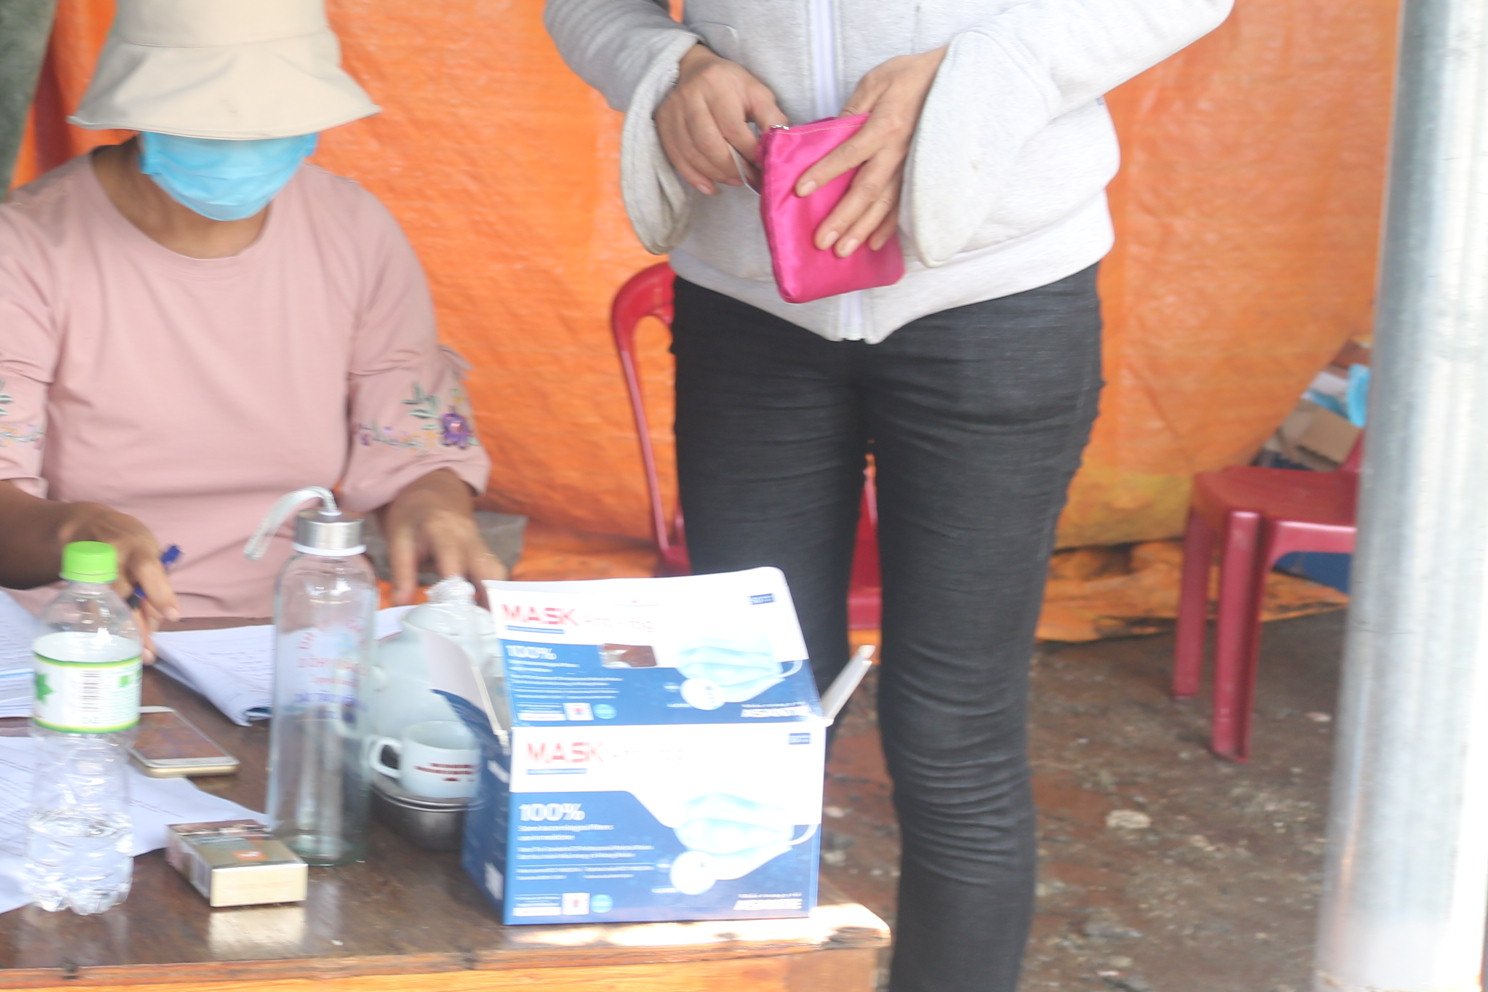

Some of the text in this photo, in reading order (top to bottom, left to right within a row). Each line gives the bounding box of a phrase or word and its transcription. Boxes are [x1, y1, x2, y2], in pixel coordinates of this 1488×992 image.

[502, 604, 578, 626] MASK
[527, 741, 605, 764] MASK
[518, 803, 586, 822] 100%
